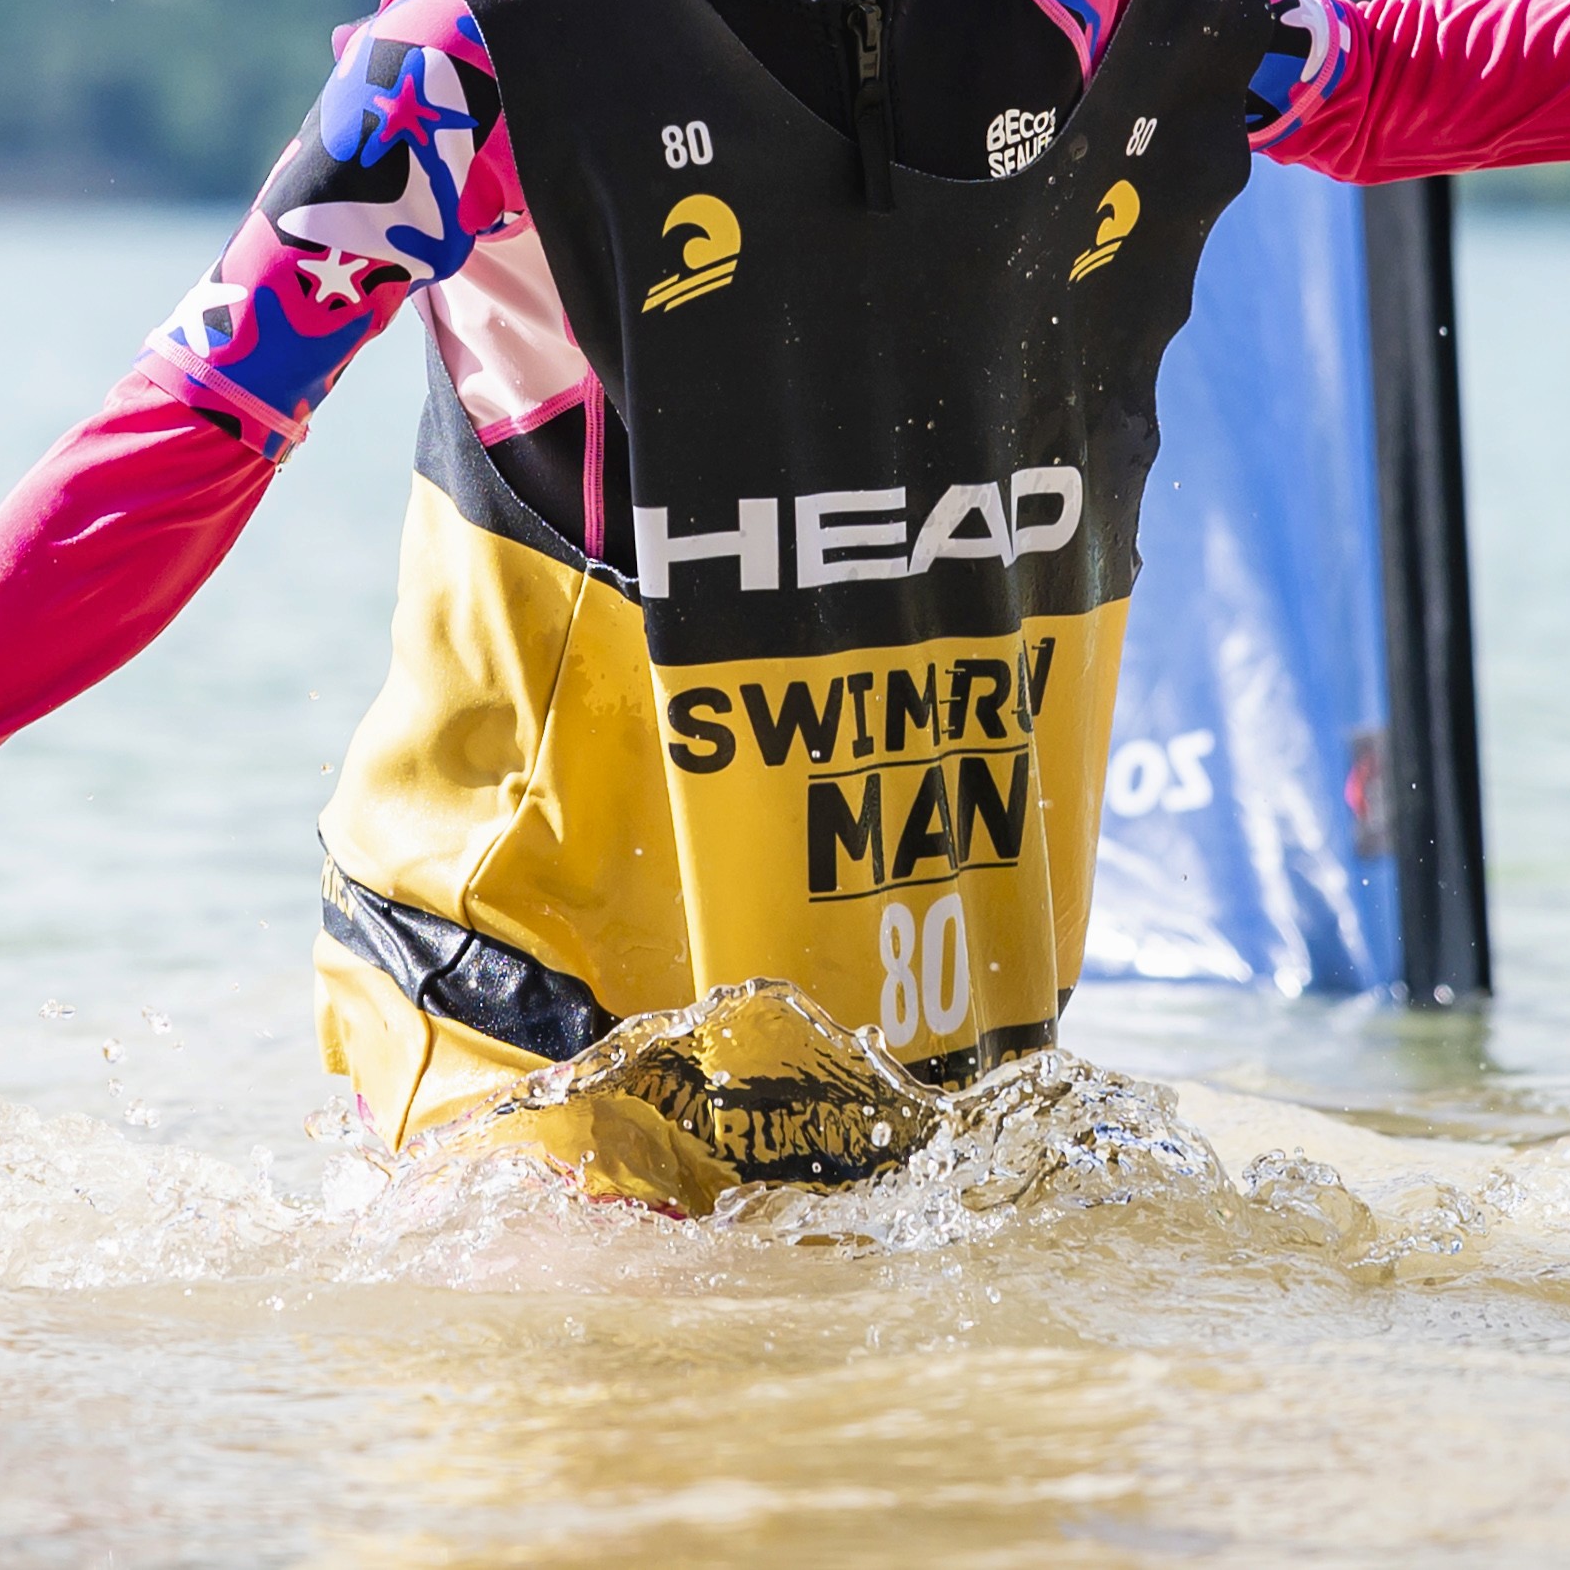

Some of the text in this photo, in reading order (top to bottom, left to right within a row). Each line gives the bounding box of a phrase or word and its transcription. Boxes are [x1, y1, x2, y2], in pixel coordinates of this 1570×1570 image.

[661, 120, 714, 169] 80
[1125, 116, 1158, 157] 80
[632, 466, 1084, 599] HEAD
[808, 750, 1030, 893] MAN
[878, 891, 971, 1049] 80
